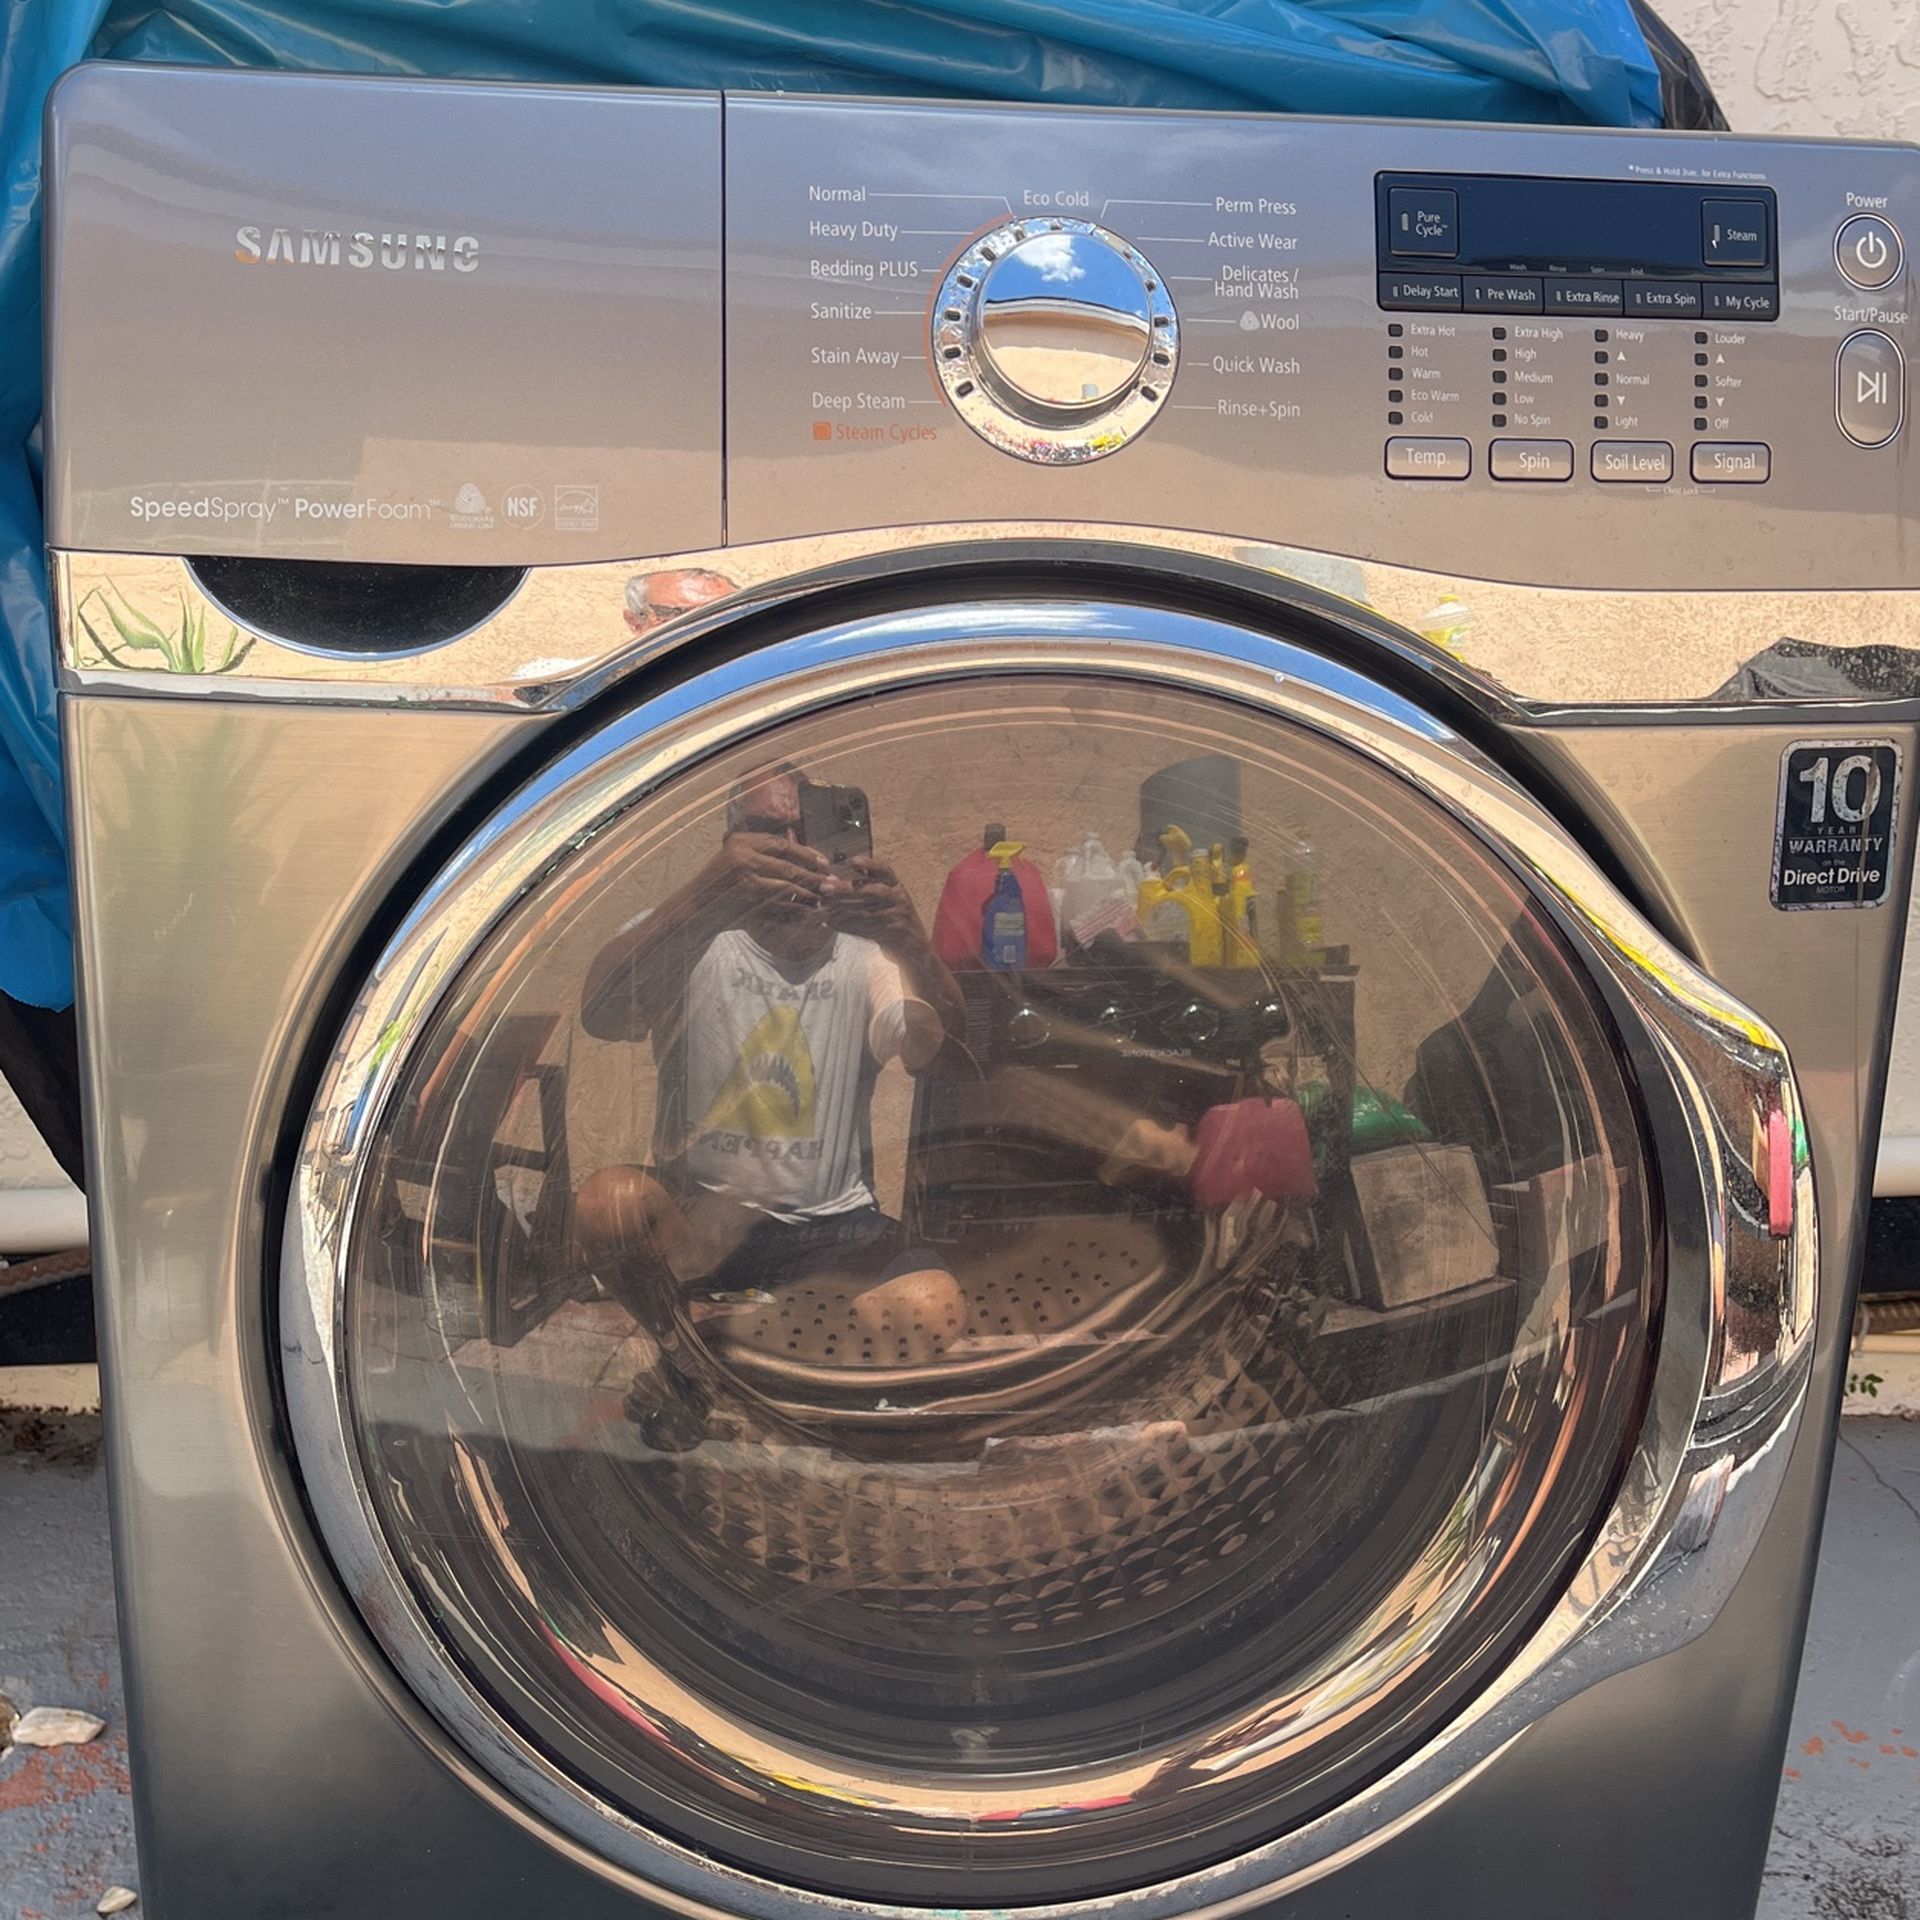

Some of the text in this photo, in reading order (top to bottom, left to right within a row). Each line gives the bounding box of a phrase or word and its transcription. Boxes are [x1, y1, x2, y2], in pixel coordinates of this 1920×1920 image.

[1733, 171, 1766, 180] Functions
[809, 186, 866, 202] Normal
[1023, 190, 1089, 207] Eco Cold
[1846, 192, 1888, 208] Power
[1215, 196, 1297, 215] Perm Press
[1417, 211, 1441, 223] Pure
[810, 221, 898, 241] Heavy Duty
[1727, 229, 1757, 242] Steam
[1208, 231, 1298, 250] Active Wear
[234, 226, 480, 273] SAMSUNG
[810, 260, 918, 280] Bedding PLUS
[1222, 264, 1289, 283] Delicates
[1509, 263, 1527, 271] Wash
[1631, 267, 1644, 276] End
[1215, 281, 1299, 299] Hand Wash
[1403, 284, 1459, 299] Delay Start
[1488, 288, 1535, 301] Pre Wash
[1566, 291, 1620, 304] Extra Rinse
[1646, 293, 1696, 307] Extra Spin
[1726, 296, 1770, 310] My Cycle
[810, 302, 872, 319] Sanitize
[1834, 306, 1908, 323] Start/Pause
[1261, 313, 1299, 330] Wool
[1411, 324, 1456, 337] Extra Hot
[1515, 326, 1563, 342] Extra High
[1616, 329, 1644, 342] Heavy
[1715, 333, 1746, 345] Louder
[811, 347, 899, 368] Stain Away
[1411, 346, 1428, 357] Hot
[1515, 349, 1536, 362] High
[1213, 355, 1300, 375] Quick Wash
[1412, 368, 1441, 379] Warm
[1515, 371, 1553, 383] Medium
[1616, 374, 1650, 385] Normal
[1715, 376, 1742, 388] Softer
[812, 392, 905, 412] Deep Steam
[1411, 390, 1460, 401] Eco Warm
[1514, 394, 1535, 404] Low
[1218, 399, 1300, 421] Rinse+Spin
[1411, 411, 1434, 423] Cold
[1514, 414, 1551, 427] No Spin
[1615, 416, 1638, 429] Light
[1715, 418, 1729, 430] Off
[836, 424, 937, 444] Steam Cycles
[1406, 448, 1450, 469] Temp.
[1519, 452, 1550, 471] Spin
[1605, 454, 1665, 471] Soil Level
[1714, 453, 1755, 473] Signal
[507, 497, 538, 517] NSF
[1799, 755, 1881, 823] 10
[1817, 826, 1857, 835] YEAR
[1789, 838, 1883, 854] WARRANTY
[1784, 867, 1880, 885] Direct Drive
[1816, 886, 1846, 895] MOTOR
